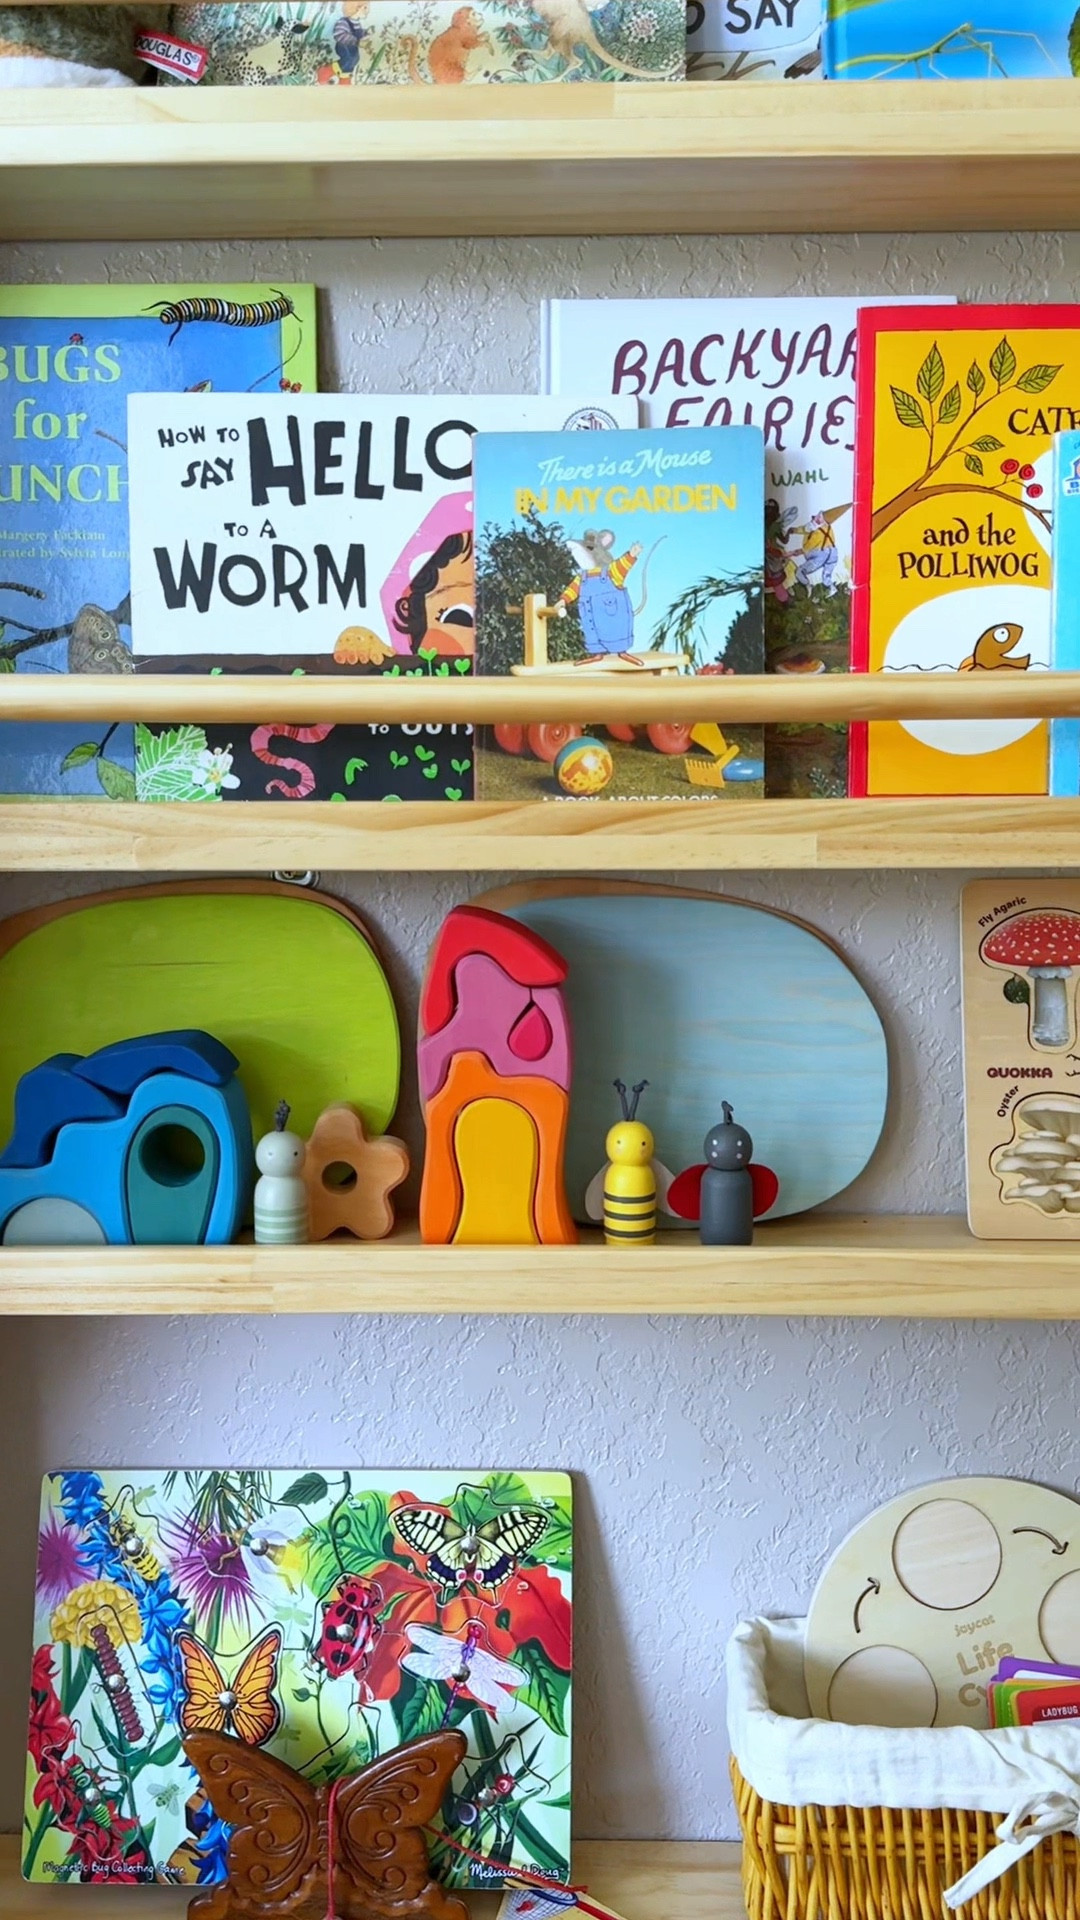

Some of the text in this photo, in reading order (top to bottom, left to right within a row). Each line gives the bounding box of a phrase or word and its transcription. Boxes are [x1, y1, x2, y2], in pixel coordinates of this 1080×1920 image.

[725, 0, 800, 34] SAY
[12, 398, 88, 440] for
[158, 425, 240, 448] HOW TO
[181, 457, 234, 489] SAY
[247, 415, 479, 506] HELLO
[537, 448, 712, 486] There is a Mouse
[771, 468, 829, 487] WAHL
[514, 483, 738, 514] IN MY GARDEN
[224, 518, 277, 538] TO A
[922, 512, 1016, 546] and the
[40, 546, 54, 561] by
[897, 552, 1039, 579] POLLIWOG
[153, 539, 367, 613] WORM
[978, 896, 1027, 927] Fly Agaric
[986, 1067, 1053, 1079] QUOKKA
[997, 1084, 1020, 1118] Oyster
[956, 1641, 1013, 1676] Life
[1041, 1705, 1078, 1718] LADYBUG
[91, 1861, 109, 1878] Bug
[111, 1860, 155, 1879] Collecting
[156, 1862, 185, 1875] Game
